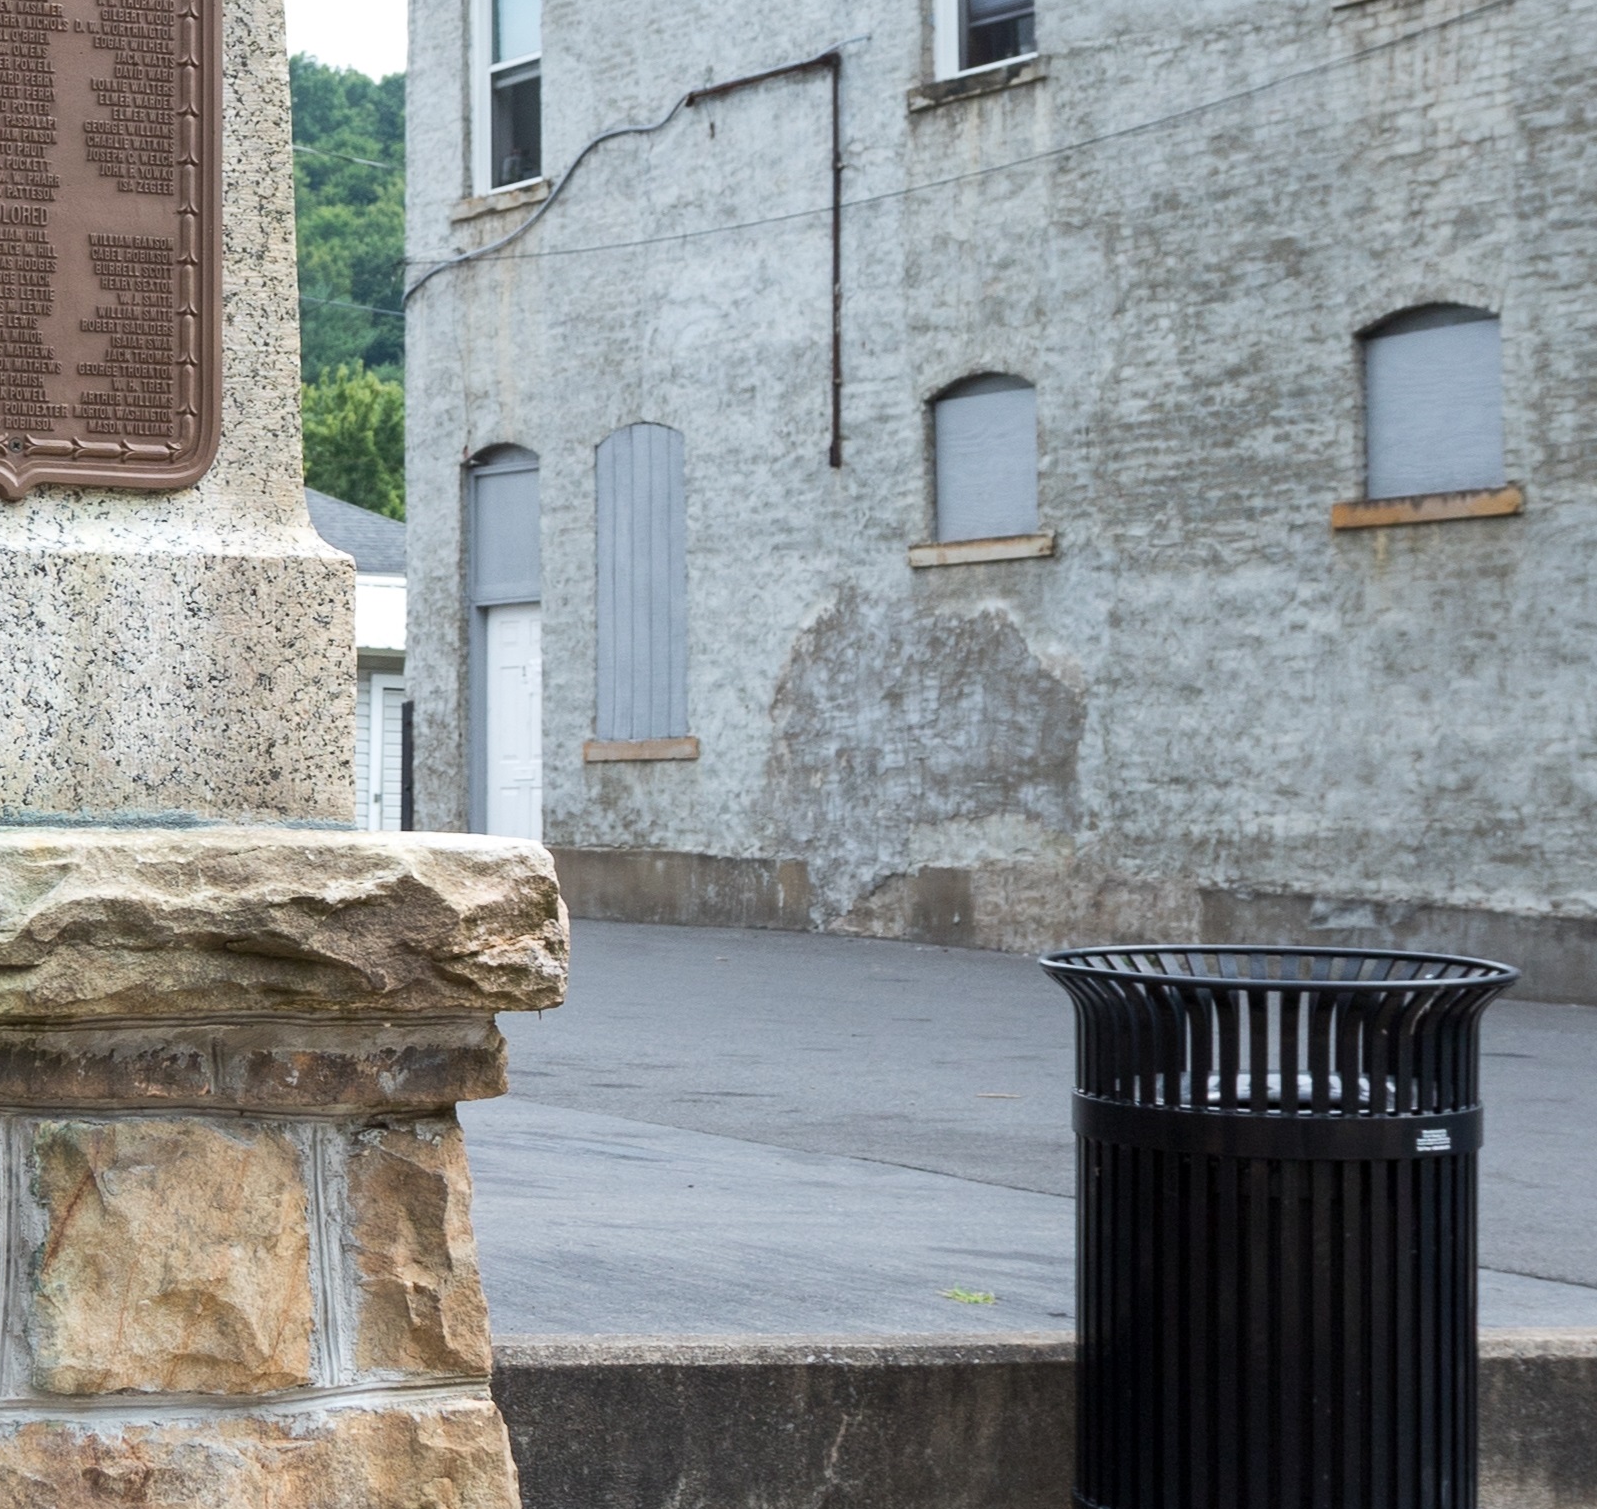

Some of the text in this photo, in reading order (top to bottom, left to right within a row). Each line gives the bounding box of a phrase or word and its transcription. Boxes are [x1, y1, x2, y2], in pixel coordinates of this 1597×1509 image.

[100, 7, 174, 26] GILBERT WOOD
[13, 57, 55, 73] POWELL
[115, 51, 174, 68] JACK WATTS
[24, 72, 54, 87] PERRY
[114, 65, 174, 82] DAVID WARD
[23, 86, 55, 101] PERRY
[11, 99, 49, 115] POTTER
[82, 119, 174, 138] GEORGE WILLIAMS
[15, 142, 46, 157] PRUIT
[6, 185, 55, 201] PATTESON
[137, 180, 174, 195] ZEGEER
[25, 229, 49, 243] HILL
[15, 257, 56, 272] HODGES
[95, 261, 173, 279] BURRELL SCOTT
[18, 271, 50, 286] LYNCH
[101, 276, 173, 293] HENRY SEXTON
[18, 286, 54, 301] LETTIE
[6, 314, 37, 329] LEWIS
[80, 318, 173, 336] ROBERT SAUNDERS
[104, 348, 173, 364] JACK THOMAS
[12, 358, 61, 373] MATHEWS
[76, 361, 173, 379] GEORGE THORNTON
[8, 387, 50, 402] POWELL
[79, 390, 173, 408] ARTHUR WILLIAMS
[4, 415, 54, 431] ROBINSON
